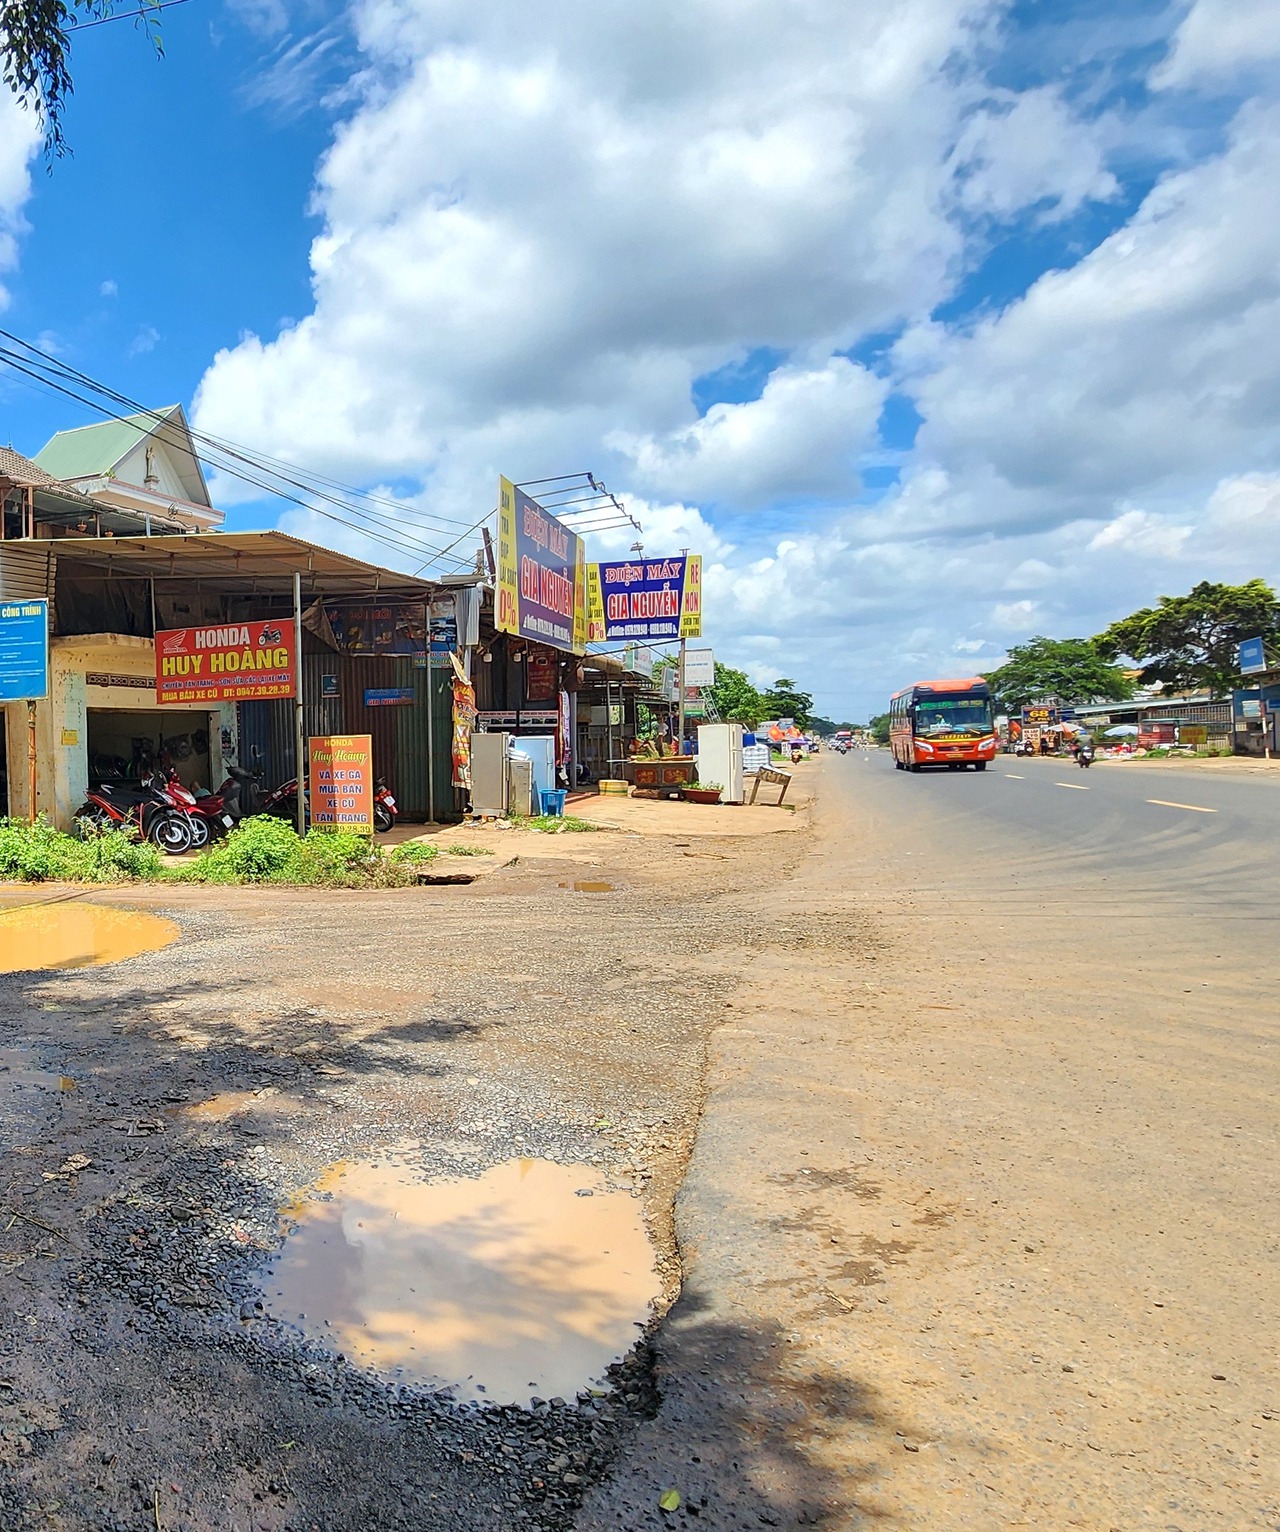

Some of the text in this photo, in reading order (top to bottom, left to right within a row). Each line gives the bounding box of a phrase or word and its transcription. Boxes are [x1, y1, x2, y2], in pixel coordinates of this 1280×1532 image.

[524, 505, 568, 562] ĐIỆN MÁY
[606, 559, 682, 586] ĐIỆN MÁY
[521, 554, 574, 619] GIA NGUYỄN
[500, 588, 516, 627] 0%
[607, 581, 678, 620] GIA NGUYỄN
[2, 606, 20, 618] CÔNG
[21, 604, 41, 616] TRÌNH
[195, 626, 251, 649] HONDA
[589, 622, 604, 640] 0%
[162, 646, 289, 677] HUY HOÀNG
[162, 681, 183, 690] CHUYÊN
[184, 680, 195, 688] TÂN
[196, 679, 214, 688] TRANG
[162, 692, 178, 701] MUA
[179, 689, 194, 700] BÁN
[196, 690, 207, 699] XE
[208, 688, 218, 698] CŨ
[236, 684, 290, 697] 0947.39.28.39
[312, 749, 368, 766] Huy Hoàng
[333, 770, 345, 779] XE
[348, 770, 361, 779] GA
[319, 783, 362, 794] MUA BÁN
[327, 798, 355, 808] XE CŨ
[315, 811, 367, 822] TÂN TRANG
[312, 825, 371, 833] 0947.39.28.39
